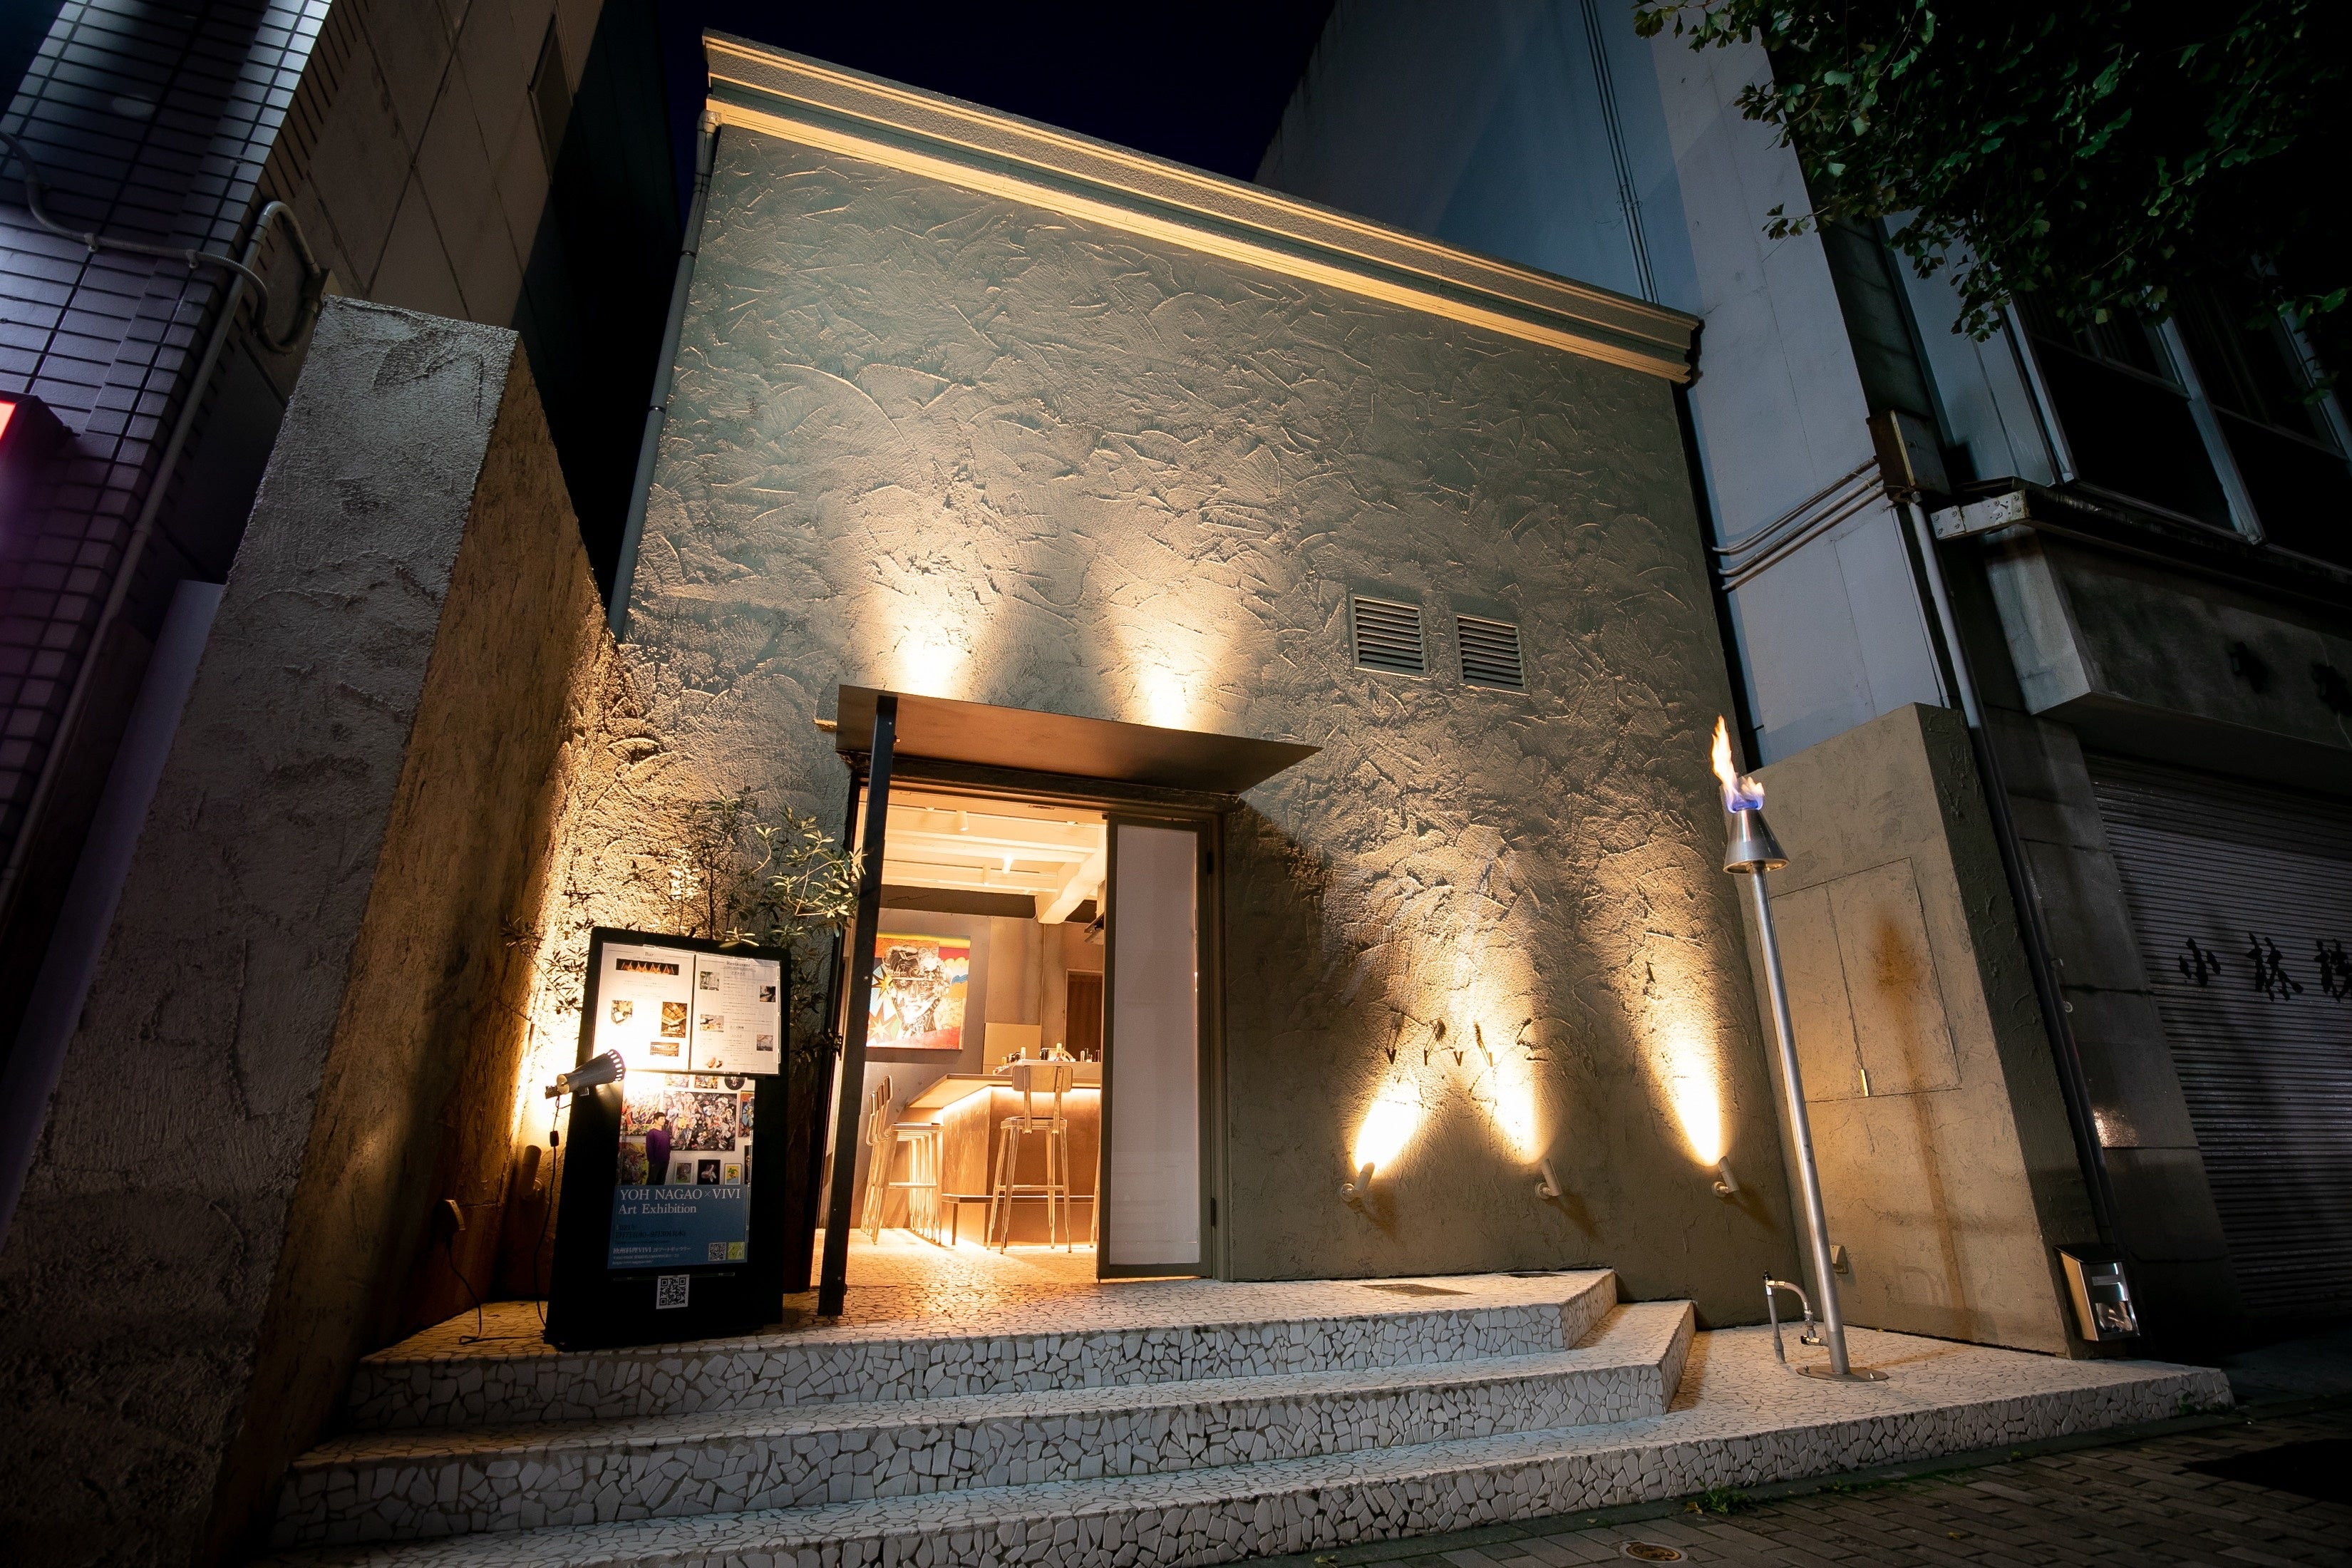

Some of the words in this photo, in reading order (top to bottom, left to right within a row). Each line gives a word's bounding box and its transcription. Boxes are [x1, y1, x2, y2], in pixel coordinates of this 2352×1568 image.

[620, 1189, 649, 1200] YOH
[618, 1204, 638, 1214] Art
[642, 1203, 697, 1214] Exhibition
